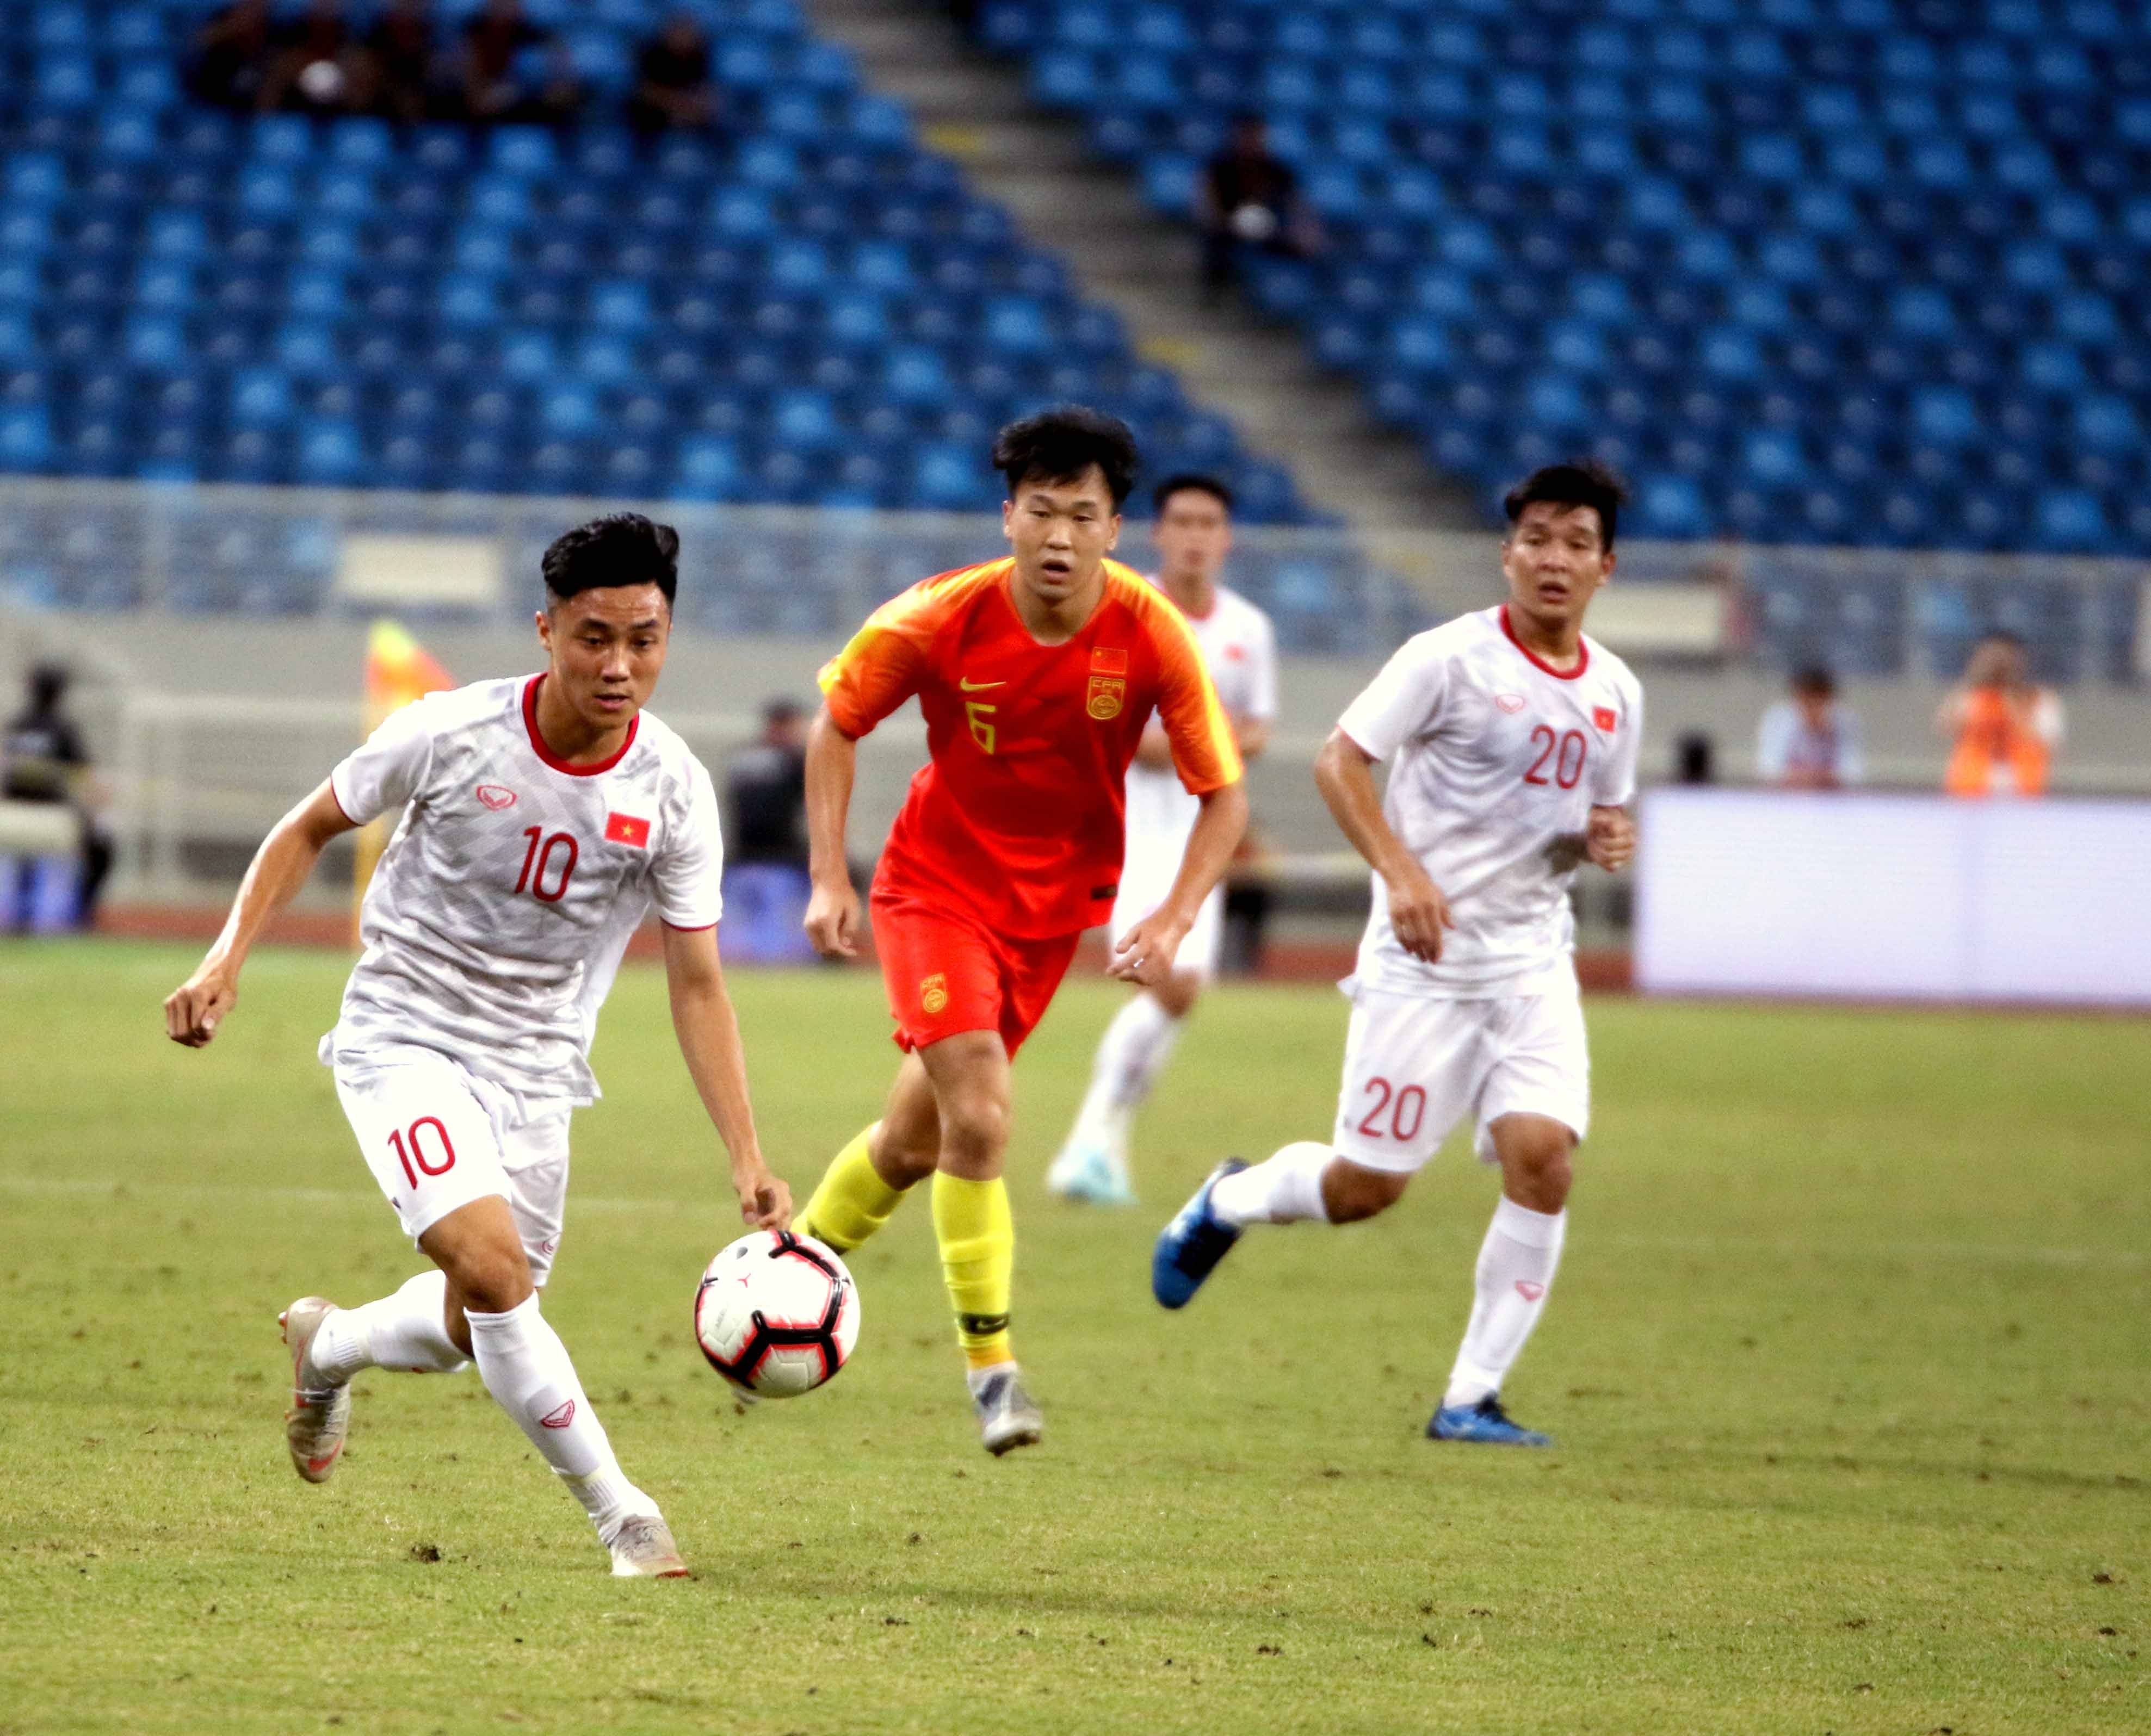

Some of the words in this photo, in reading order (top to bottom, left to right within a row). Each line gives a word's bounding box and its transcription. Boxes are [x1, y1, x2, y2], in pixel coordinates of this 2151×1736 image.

[965, 701, 997, 754] 6
[1524, 723, 1587, 789] 20
[514, 826, 578, 902] 10
[1358, 1076, 1426, 1140] 20
[387, 1116, 455, 1190] 10
